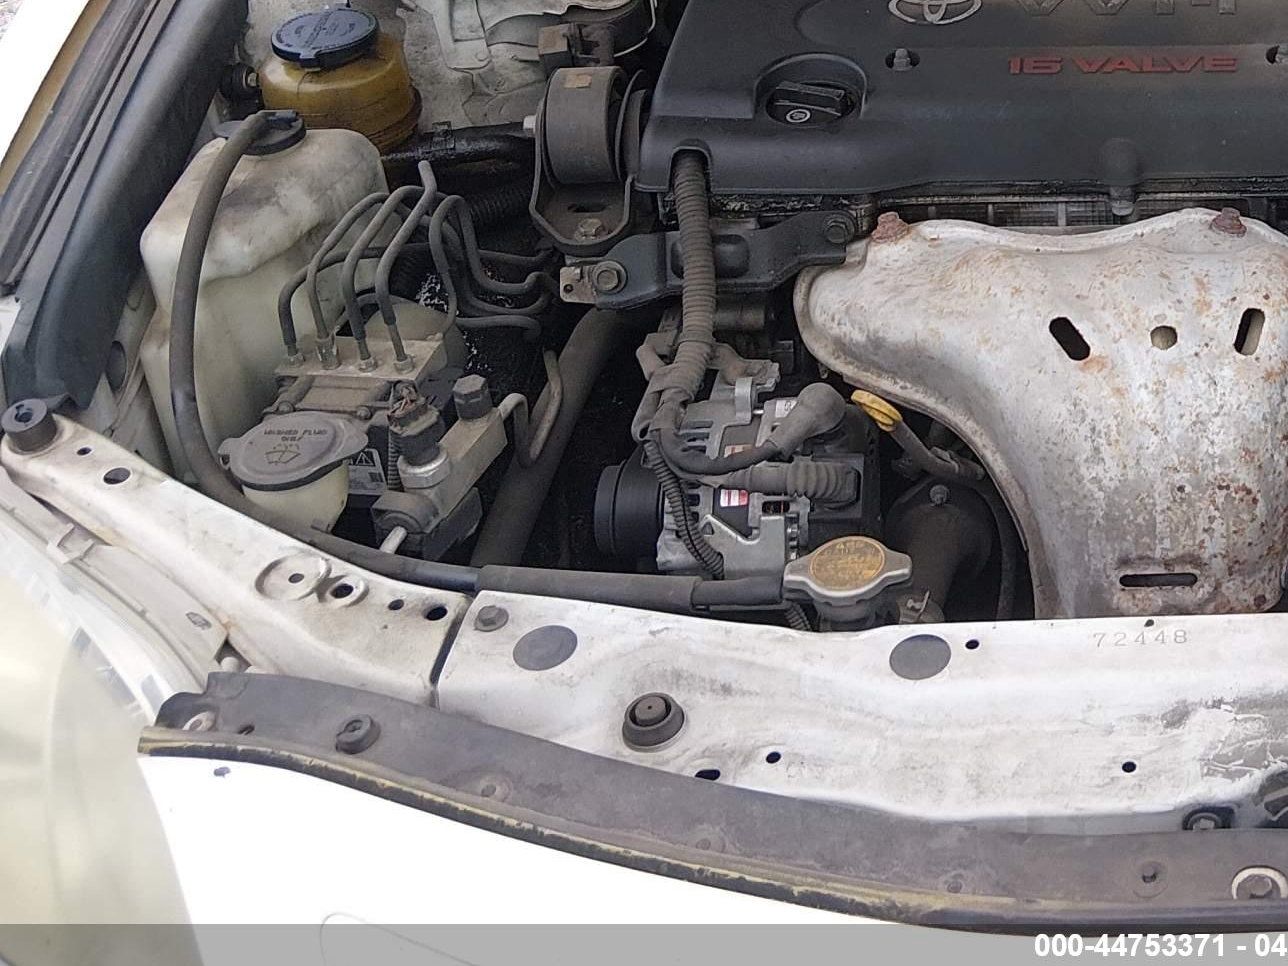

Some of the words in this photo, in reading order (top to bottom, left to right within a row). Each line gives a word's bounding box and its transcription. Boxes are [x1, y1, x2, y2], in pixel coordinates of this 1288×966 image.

[1008, 57, 1062, 74] 16
[1072, 56, 1237, 73] VALVE
[1093, 630, 1187, 647] 72448
